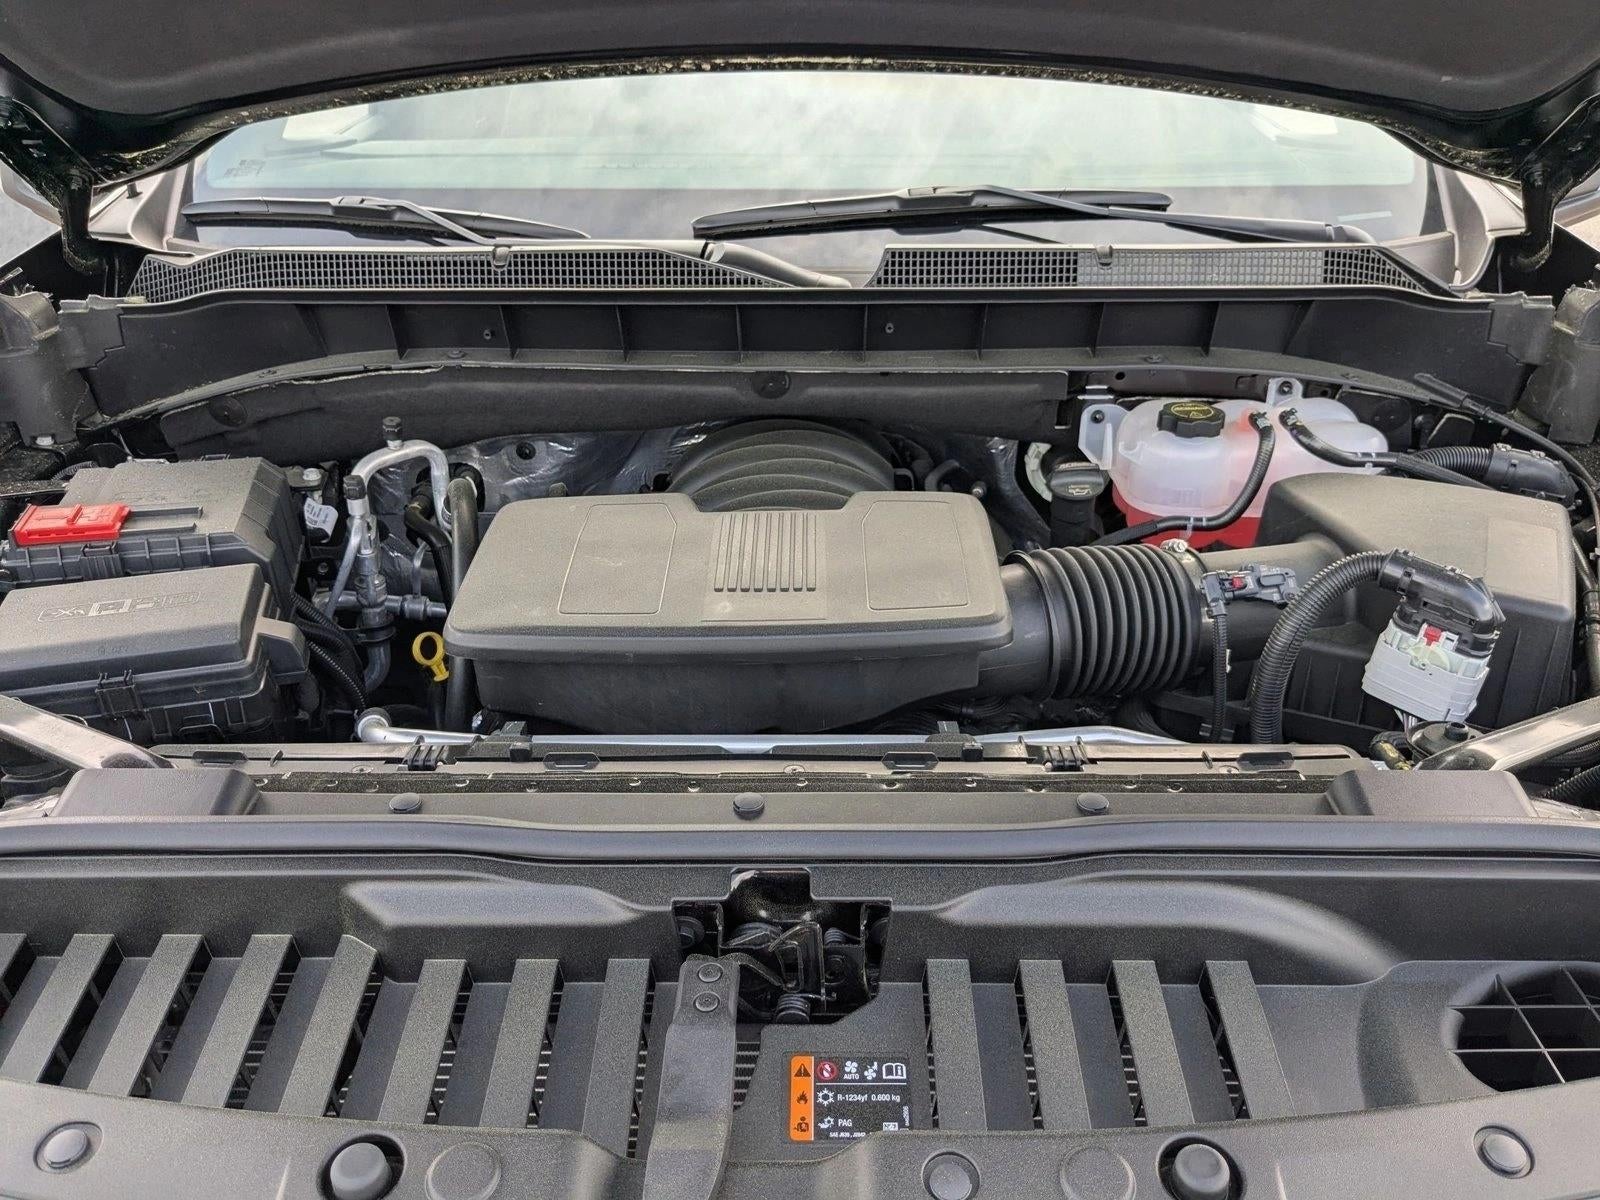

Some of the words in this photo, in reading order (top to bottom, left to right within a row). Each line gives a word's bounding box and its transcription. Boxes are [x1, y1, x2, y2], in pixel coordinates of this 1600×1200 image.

[837, 1094, 868, 1103] R-1234yf
[891, 1094, 901, 1103] kg
[838, 1118, 853, 1127] PAG
